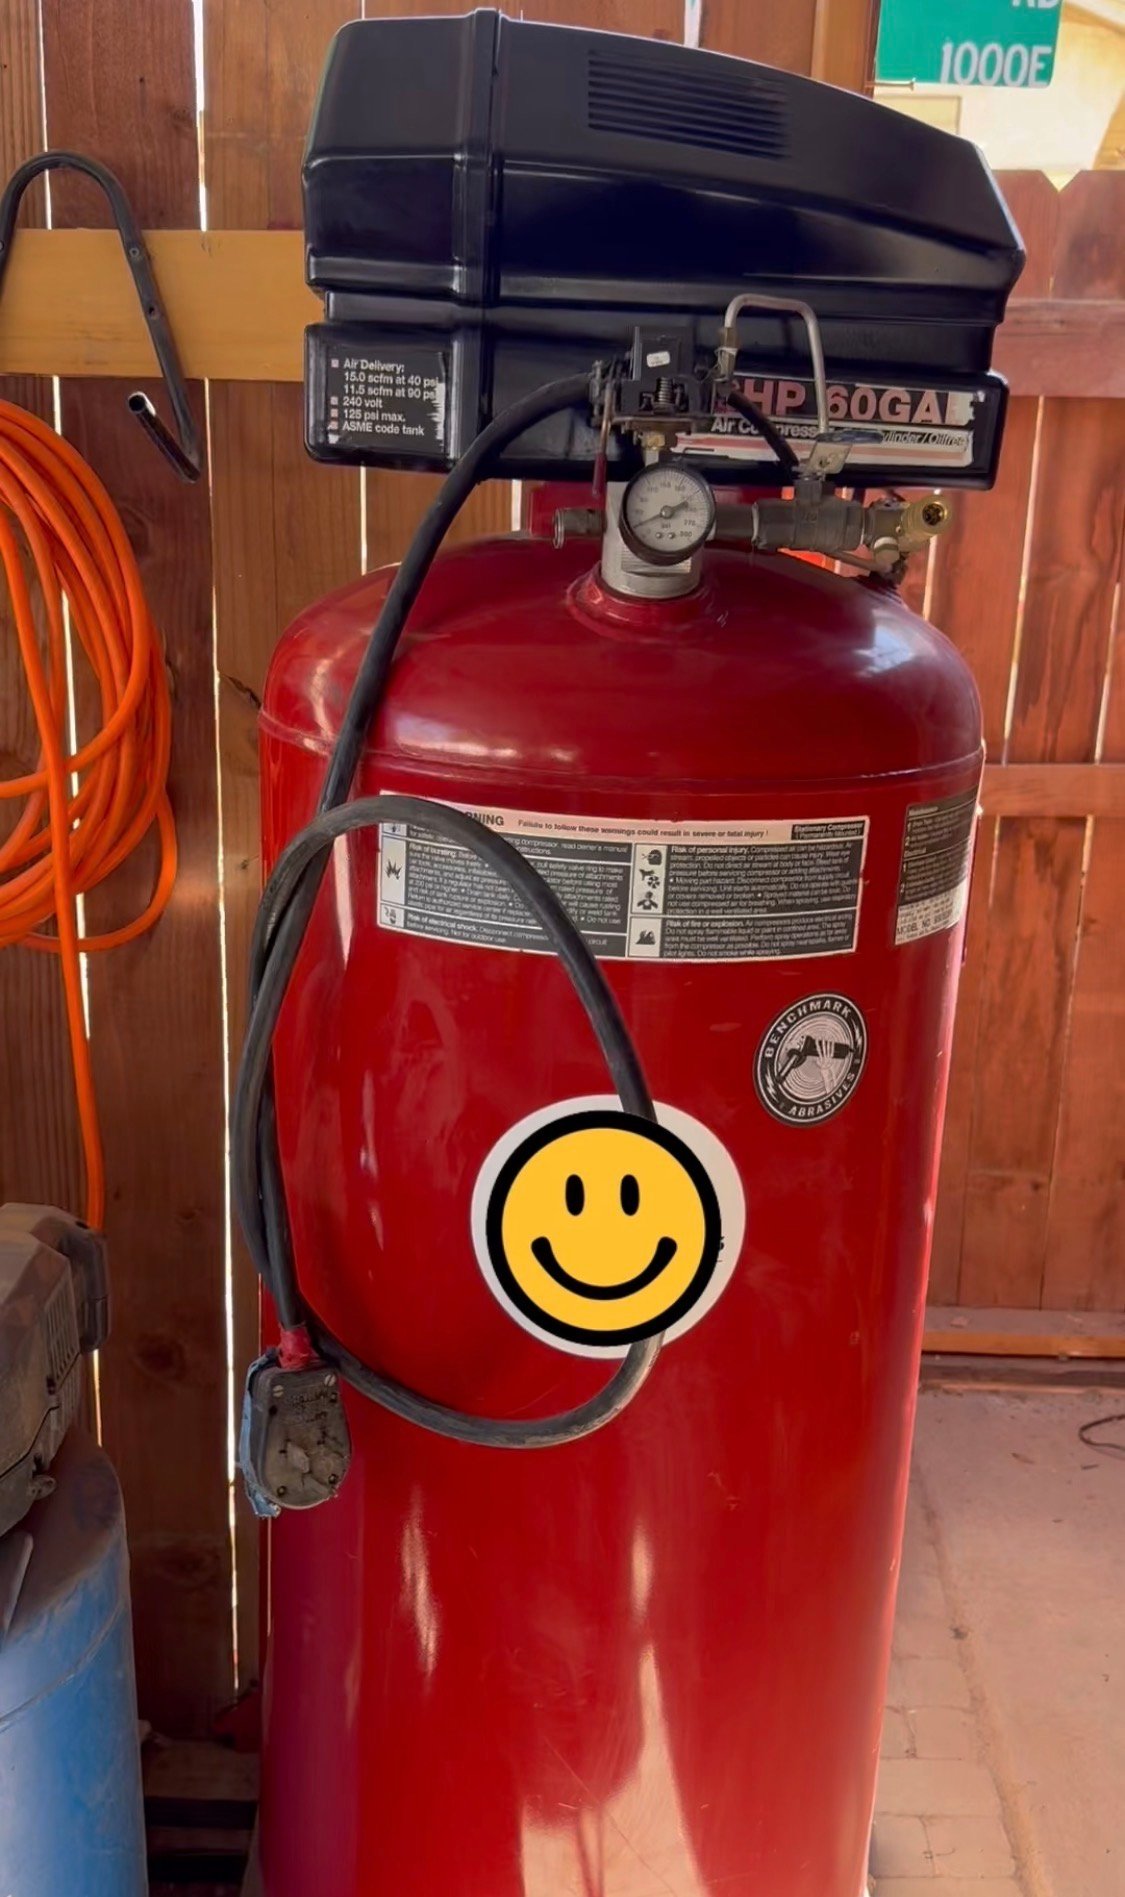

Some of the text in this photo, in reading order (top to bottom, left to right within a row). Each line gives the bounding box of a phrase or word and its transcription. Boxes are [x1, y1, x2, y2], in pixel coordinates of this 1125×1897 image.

[940, 41, 1052, 88] 1000E
[343, 358, 405, 374] Air Delivery:
[344, 372, 439, 388] 15.0 scfm at 40 psi
[344, 384, 366, 394] 11.5
[368, 386, 394, 396] scfm
[395, 388, 406, 398] at
[407, 388, 422, 398] 90
[343, 396, 383, 408] 240 volt
[343, 408, 406, 422] 125 psi max.
[342, 421, 425, 436] ASME code tank
[711, 417, 736, 432] Air
[545, 822, 554, 830] to
[764, 1000, 852, 1058] BENCHMARK
[788, 1072, 856, 1117] ABRASIVES
